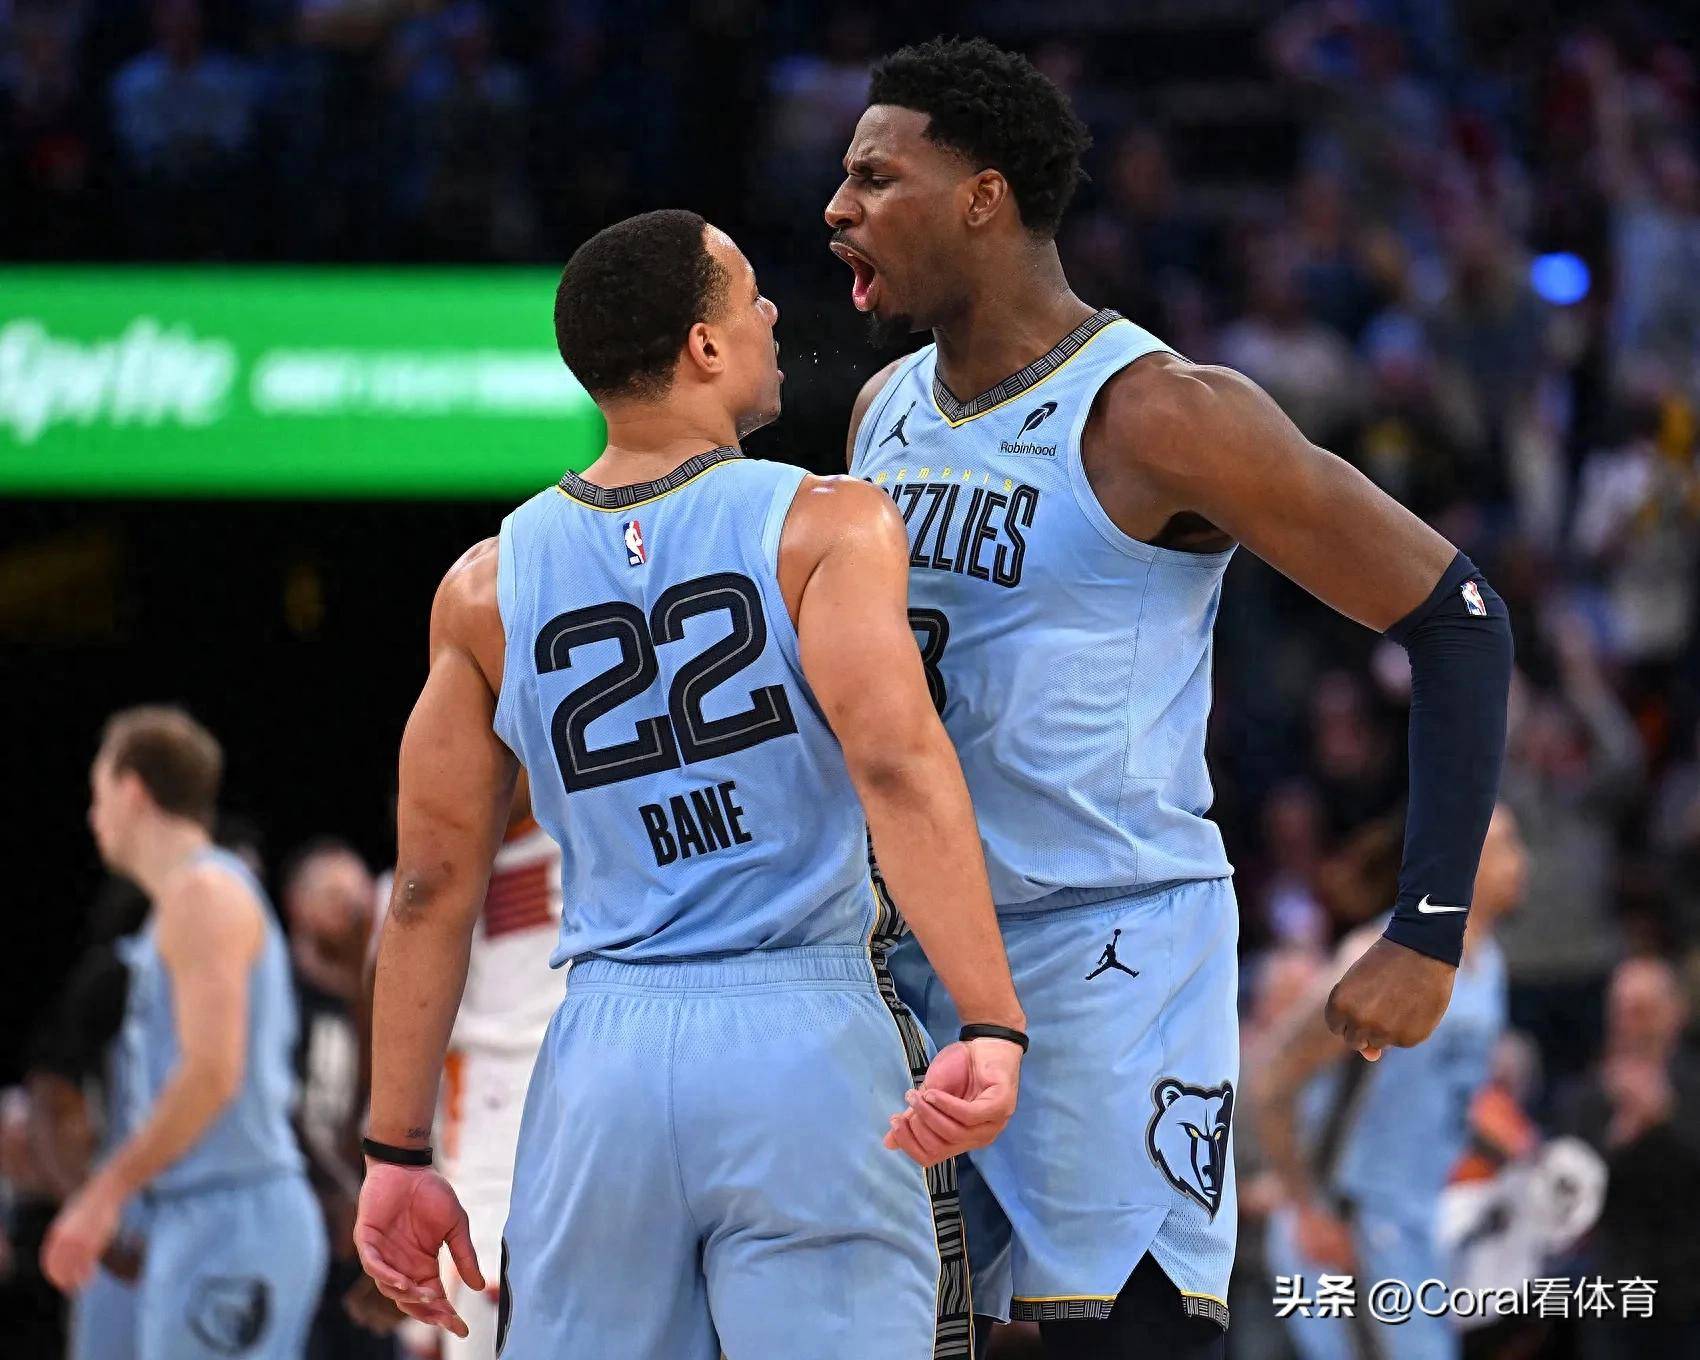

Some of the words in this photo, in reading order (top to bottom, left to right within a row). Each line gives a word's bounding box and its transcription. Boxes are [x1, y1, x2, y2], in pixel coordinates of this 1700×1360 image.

[875, 466, 1014, 492] MEMPHIS
[1000, 441, 1057, 457] Robinhood
[866, 480, 1040, 588] ZZLIES
[534, 572, 799, 794] 22
[638, 780, 753, 868] BANE
